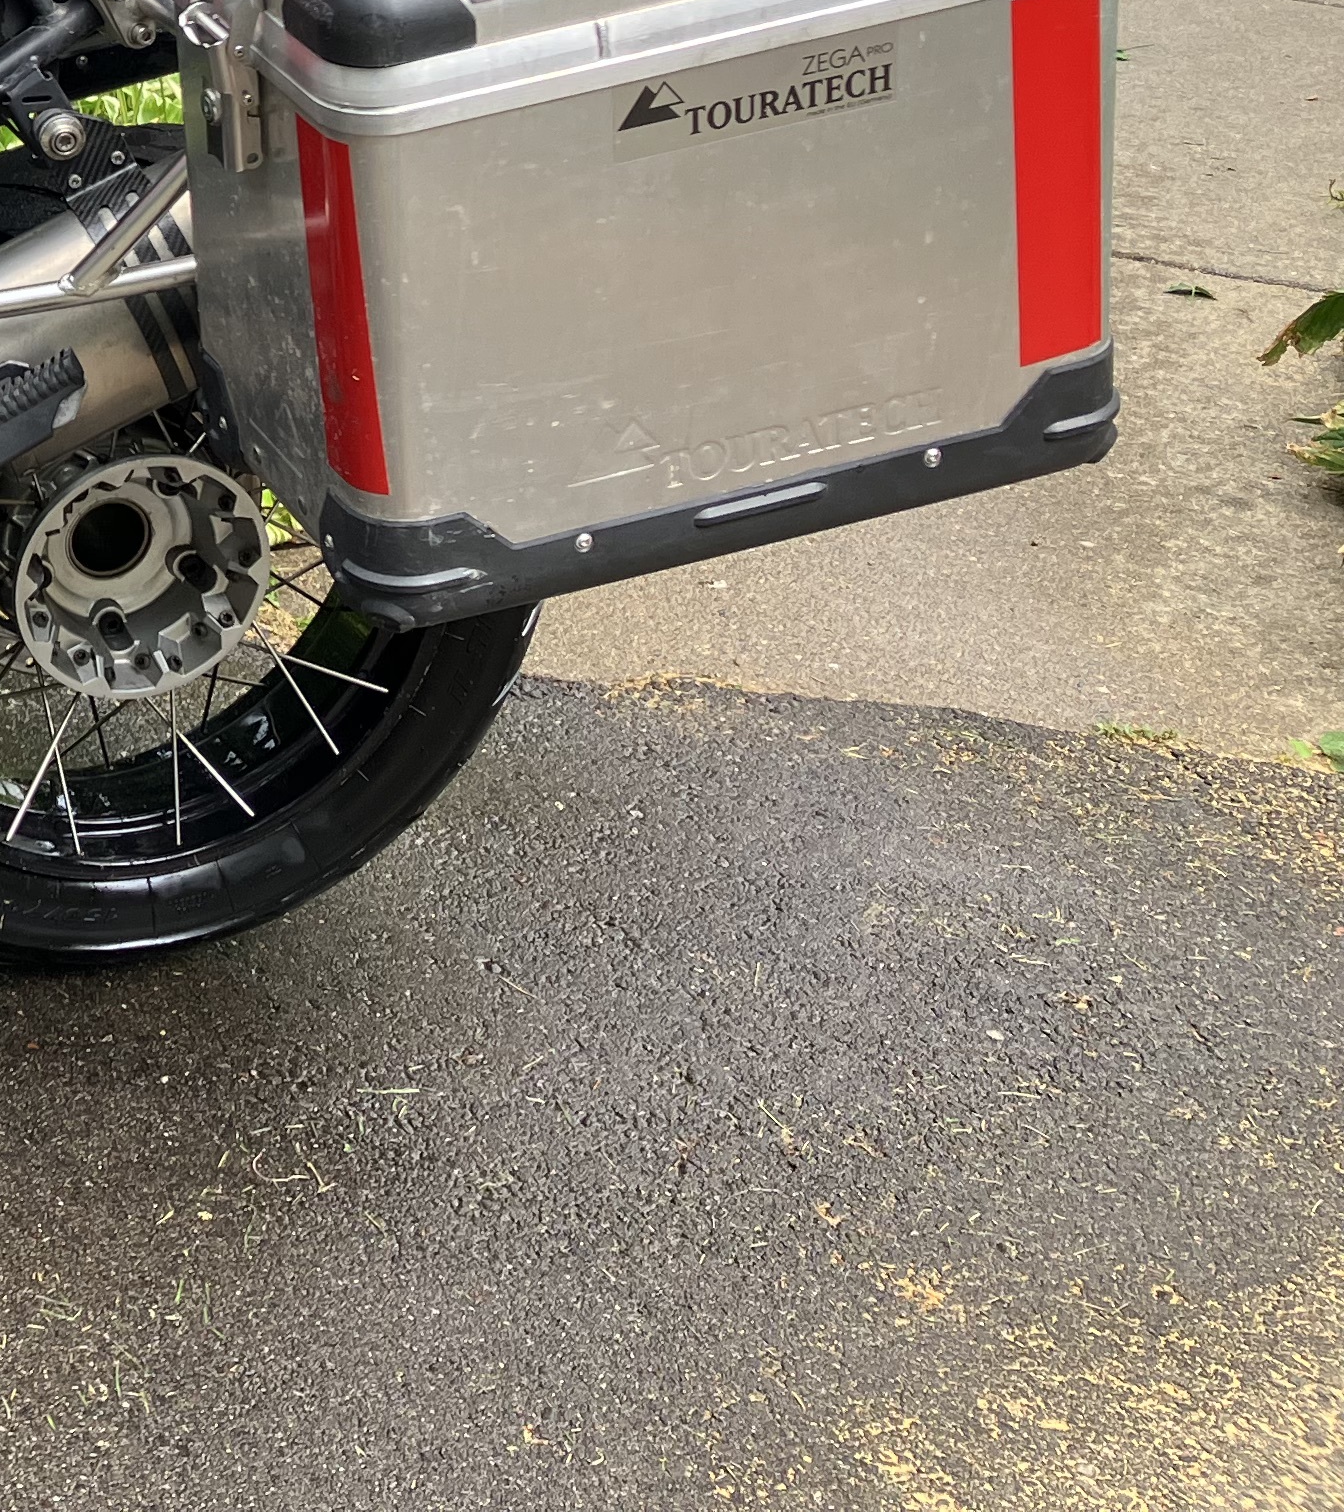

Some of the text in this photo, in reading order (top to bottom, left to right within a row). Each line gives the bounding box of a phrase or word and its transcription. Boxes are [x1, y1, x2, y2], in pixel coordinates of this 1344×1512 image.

[801, 41, 895, 76] ZEGA PRO
[684, 62, 894, 136] TOURATECH
[659, 386, 945, 489] TOURATECH
